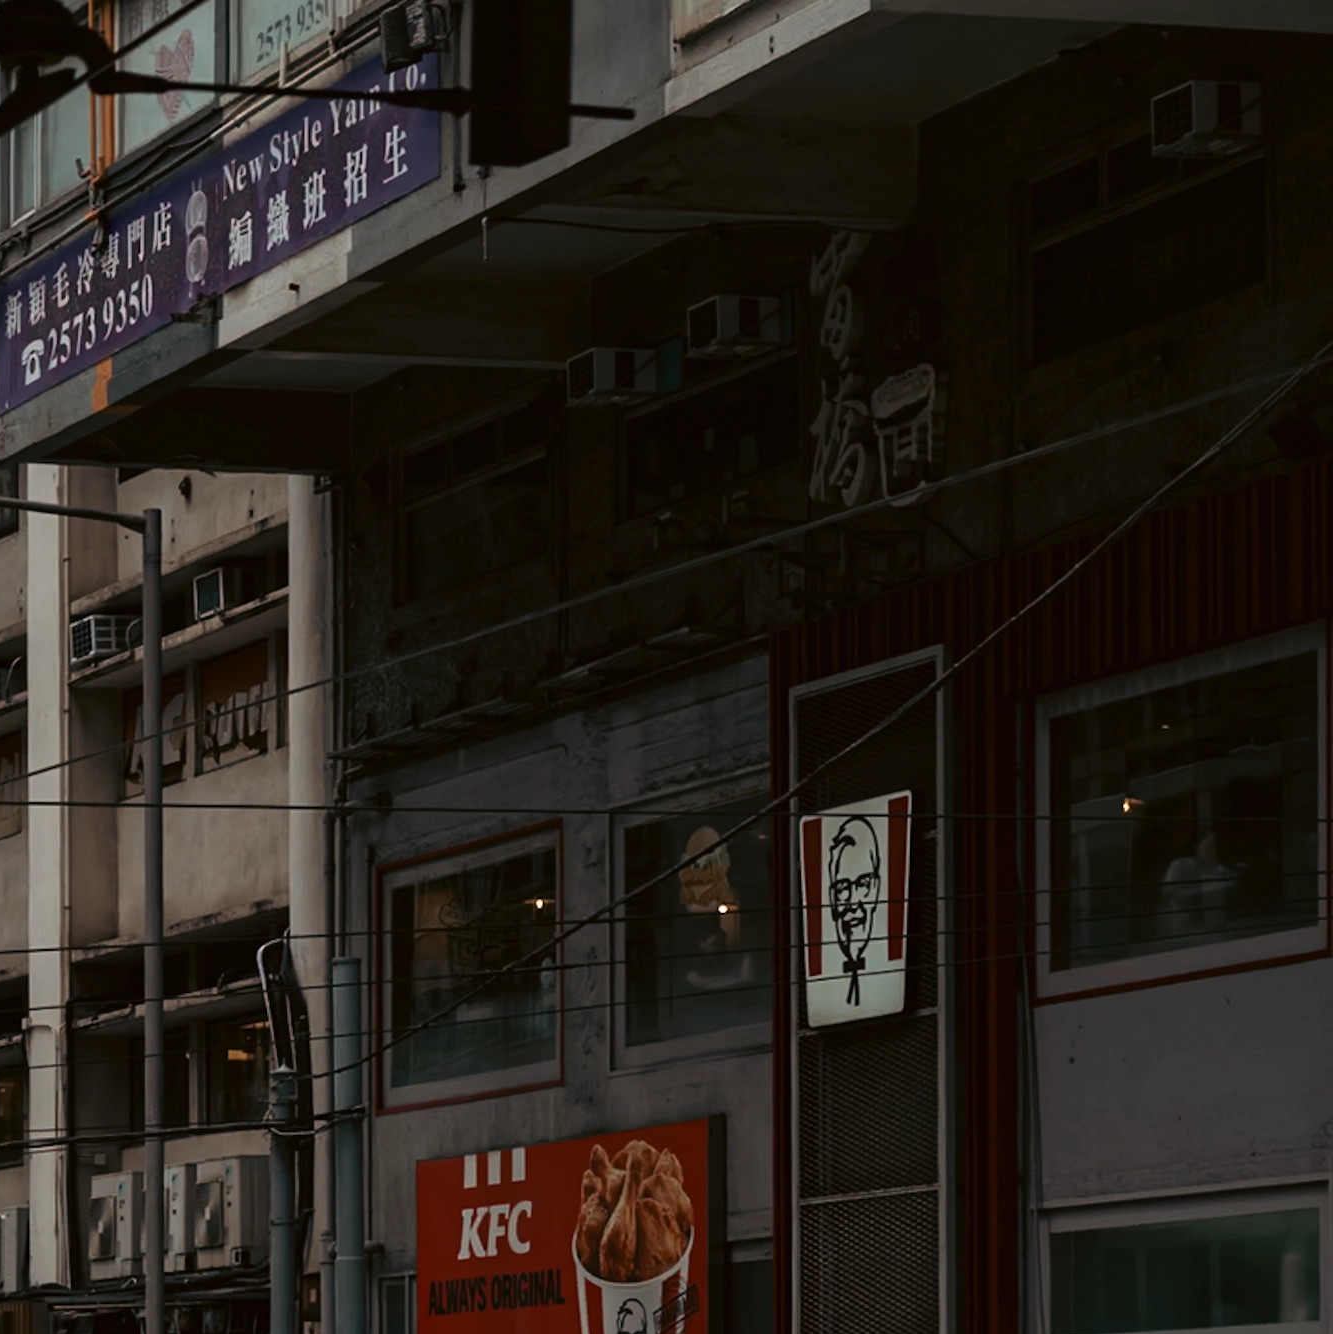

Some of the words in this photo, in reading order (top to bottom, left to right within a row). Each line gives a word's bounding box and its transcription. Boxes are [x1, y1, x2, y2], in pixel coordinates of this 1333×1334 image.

[223, 151, 264, 201] New
[269, 116, 322, 174] Style
[329, 85, 380, 136] Yarn
[228, 125, 408, 270] 編織班招生
[47, 306, 96, 370] 2573
[103, 274, 154, 342] 9350
[457, 1200, 532, 1260] KFC
[428, 1277, 487, 1316] ALWAYS
[491, 1269, 565, 1311] ORIGINAL
